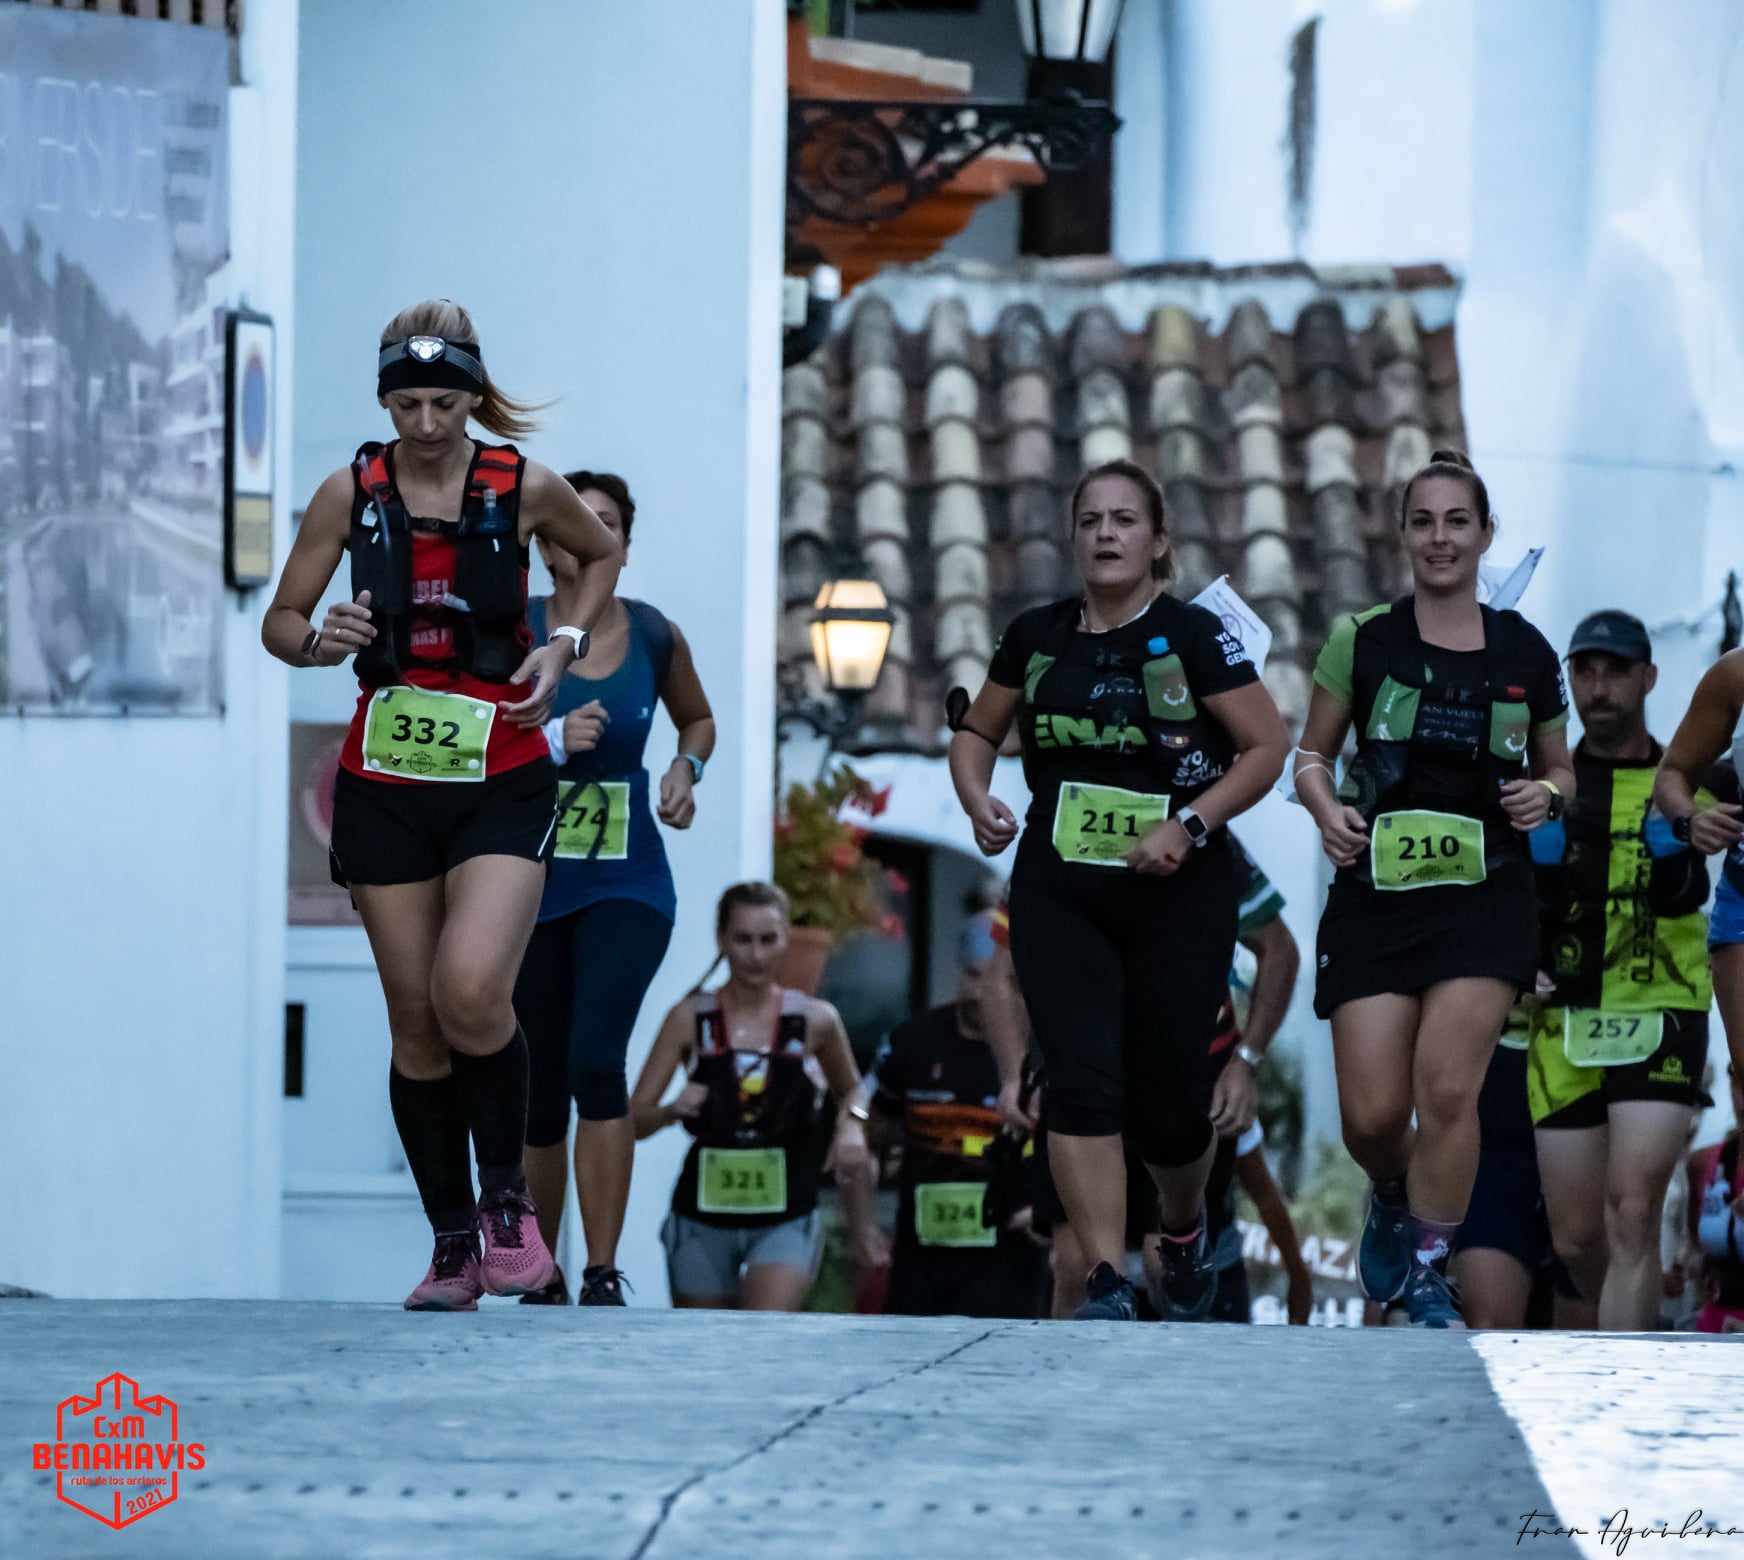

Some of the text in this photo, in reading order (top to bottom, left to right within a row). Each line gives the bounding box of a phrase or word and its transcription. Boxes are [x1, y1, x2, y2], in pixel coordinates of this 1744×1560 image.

[392, 714, 461, 749] 332
[557, 806, 608, 830] 274
[1080, 809, 1140, 838] 211
[1398, 834, 1460, 861] 210
[1588, 1018, 1641, 1040] 257
[719, 1168, 766, 1190] 321
